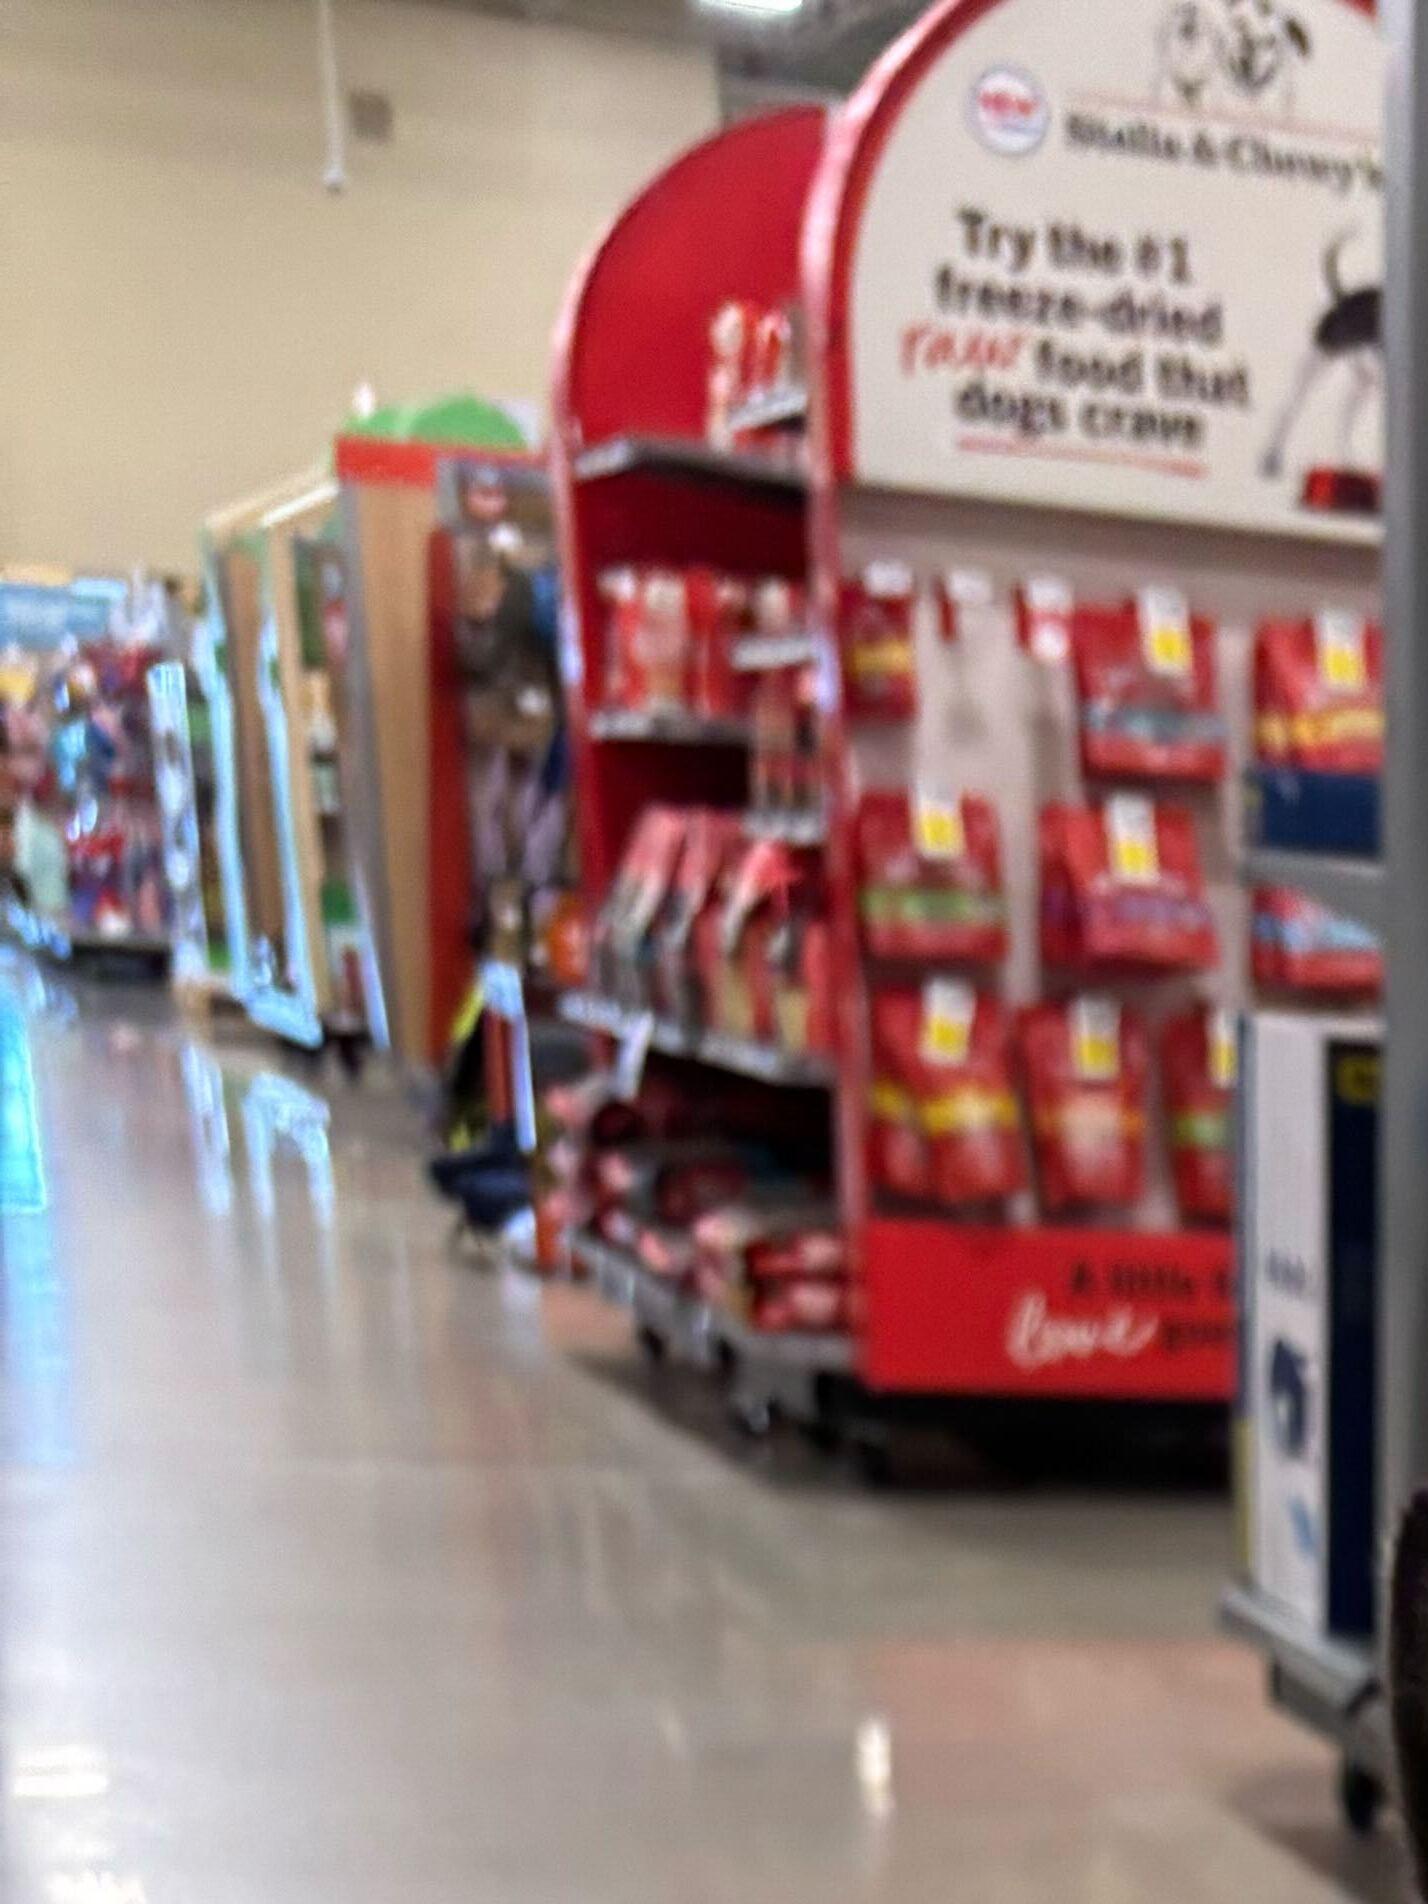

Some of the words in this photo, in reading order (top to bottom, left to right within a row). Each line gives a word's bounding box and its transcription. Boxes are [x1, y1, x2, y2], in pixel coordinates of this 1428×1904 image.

[1192, 127, 1220, 168] &
[957, 203, 1036, 276] Try
[1048, 220, 1122, 276] the
[1136, 233, 1190, 286] #1
[935, 263, 1222, 346] freeze-dried
[1034, 337, 1144, 395] food
[1156, 352, 1250, 411] that
[955, 379, 1071, 438] dogs
[1077, 401, 1203, 448] crave
